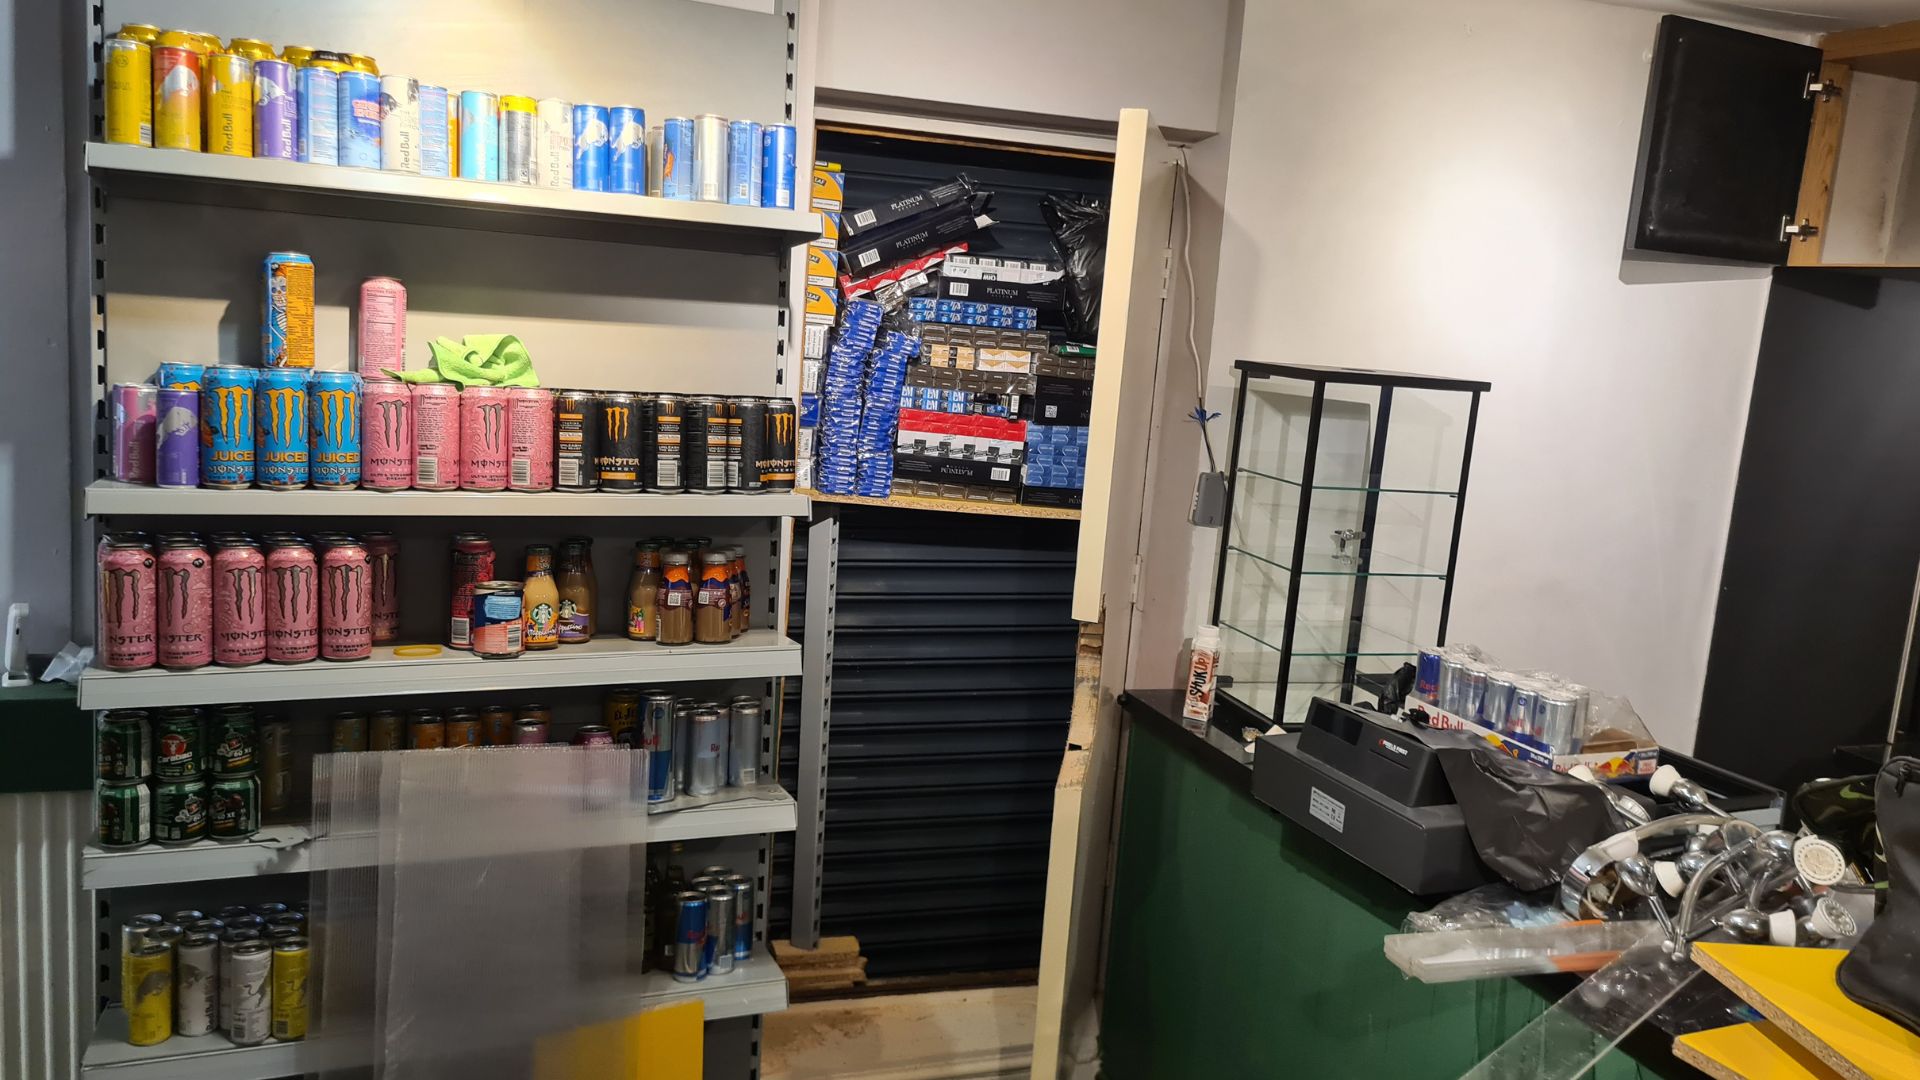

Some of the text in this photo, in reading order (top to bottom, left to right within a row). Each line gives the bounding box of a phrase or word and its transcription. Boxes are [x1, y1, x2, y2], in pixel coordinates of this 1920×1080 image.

[890, 194, 923, 210] PLATINUM
[895, 231, 929, 248] PLATINUM
[986, 287, 1019, 297] PLATINUM
